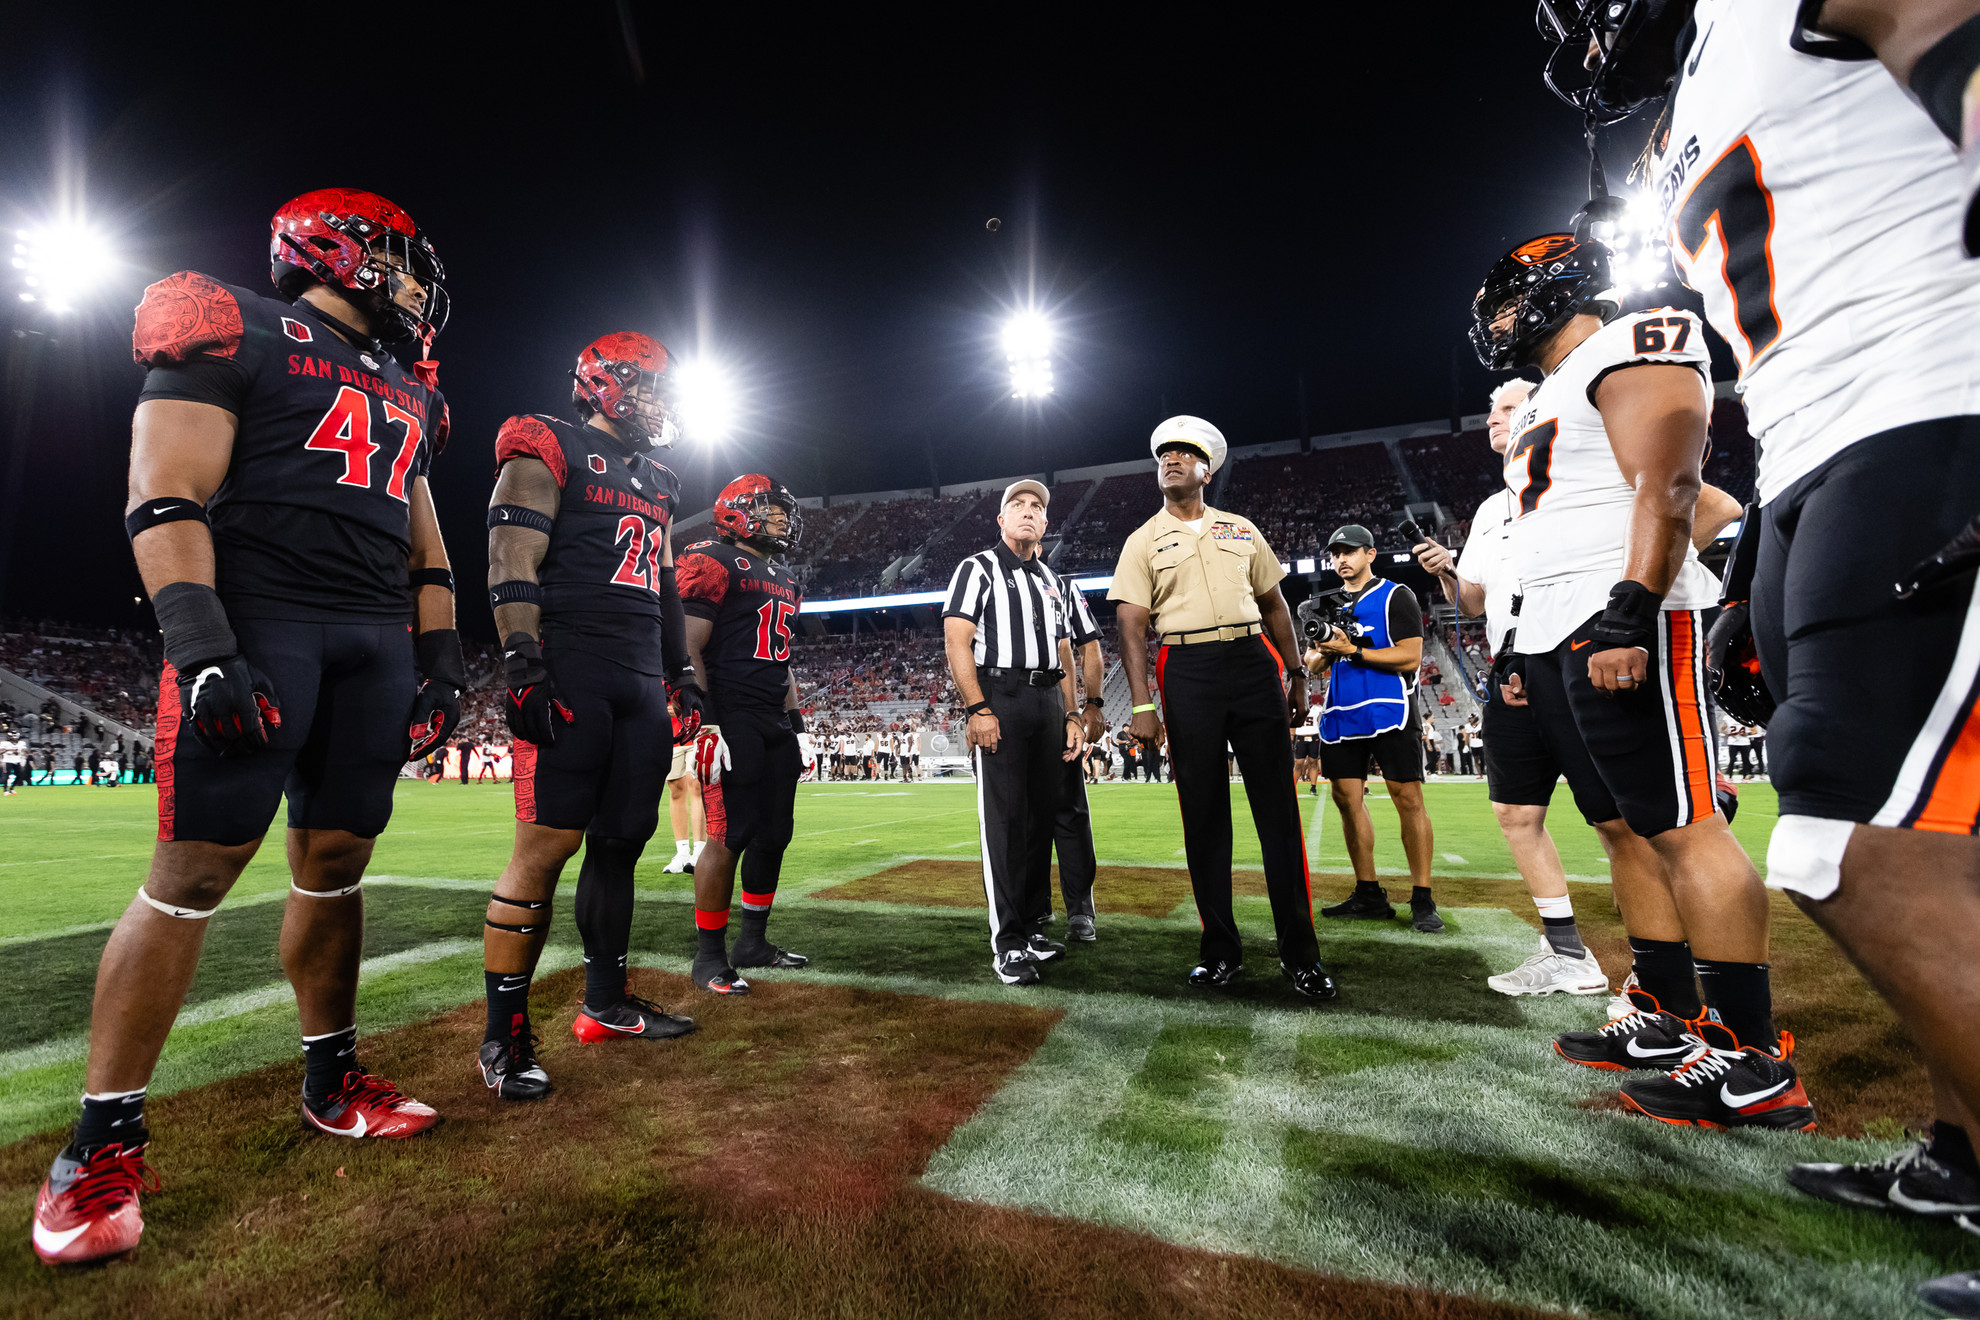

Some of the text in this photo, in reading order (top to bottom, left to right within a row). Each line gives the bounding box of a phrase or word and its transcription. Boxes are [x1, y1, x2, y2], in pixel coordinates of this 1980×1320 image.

[1669, 133, 1782, 378] 7
[1632, 316, 1692, 355] 67
[288, 354, 332, 380] SAN
[337, 365, 395, 401] DIEGO
[304, 385, 422, 503] 47
[584, 484, 614, 505] SAN
[617, 491, 651, 516] DIEGO
[610, 514, 663, 596] 21
[739, 578, 760, 592] SAN
[762, 580, 785, 598] DIEGO
[1007, 579, 1016, 589] S
[753, 598, 796, 661] 15
[1055, 610, 1063, 626] R
